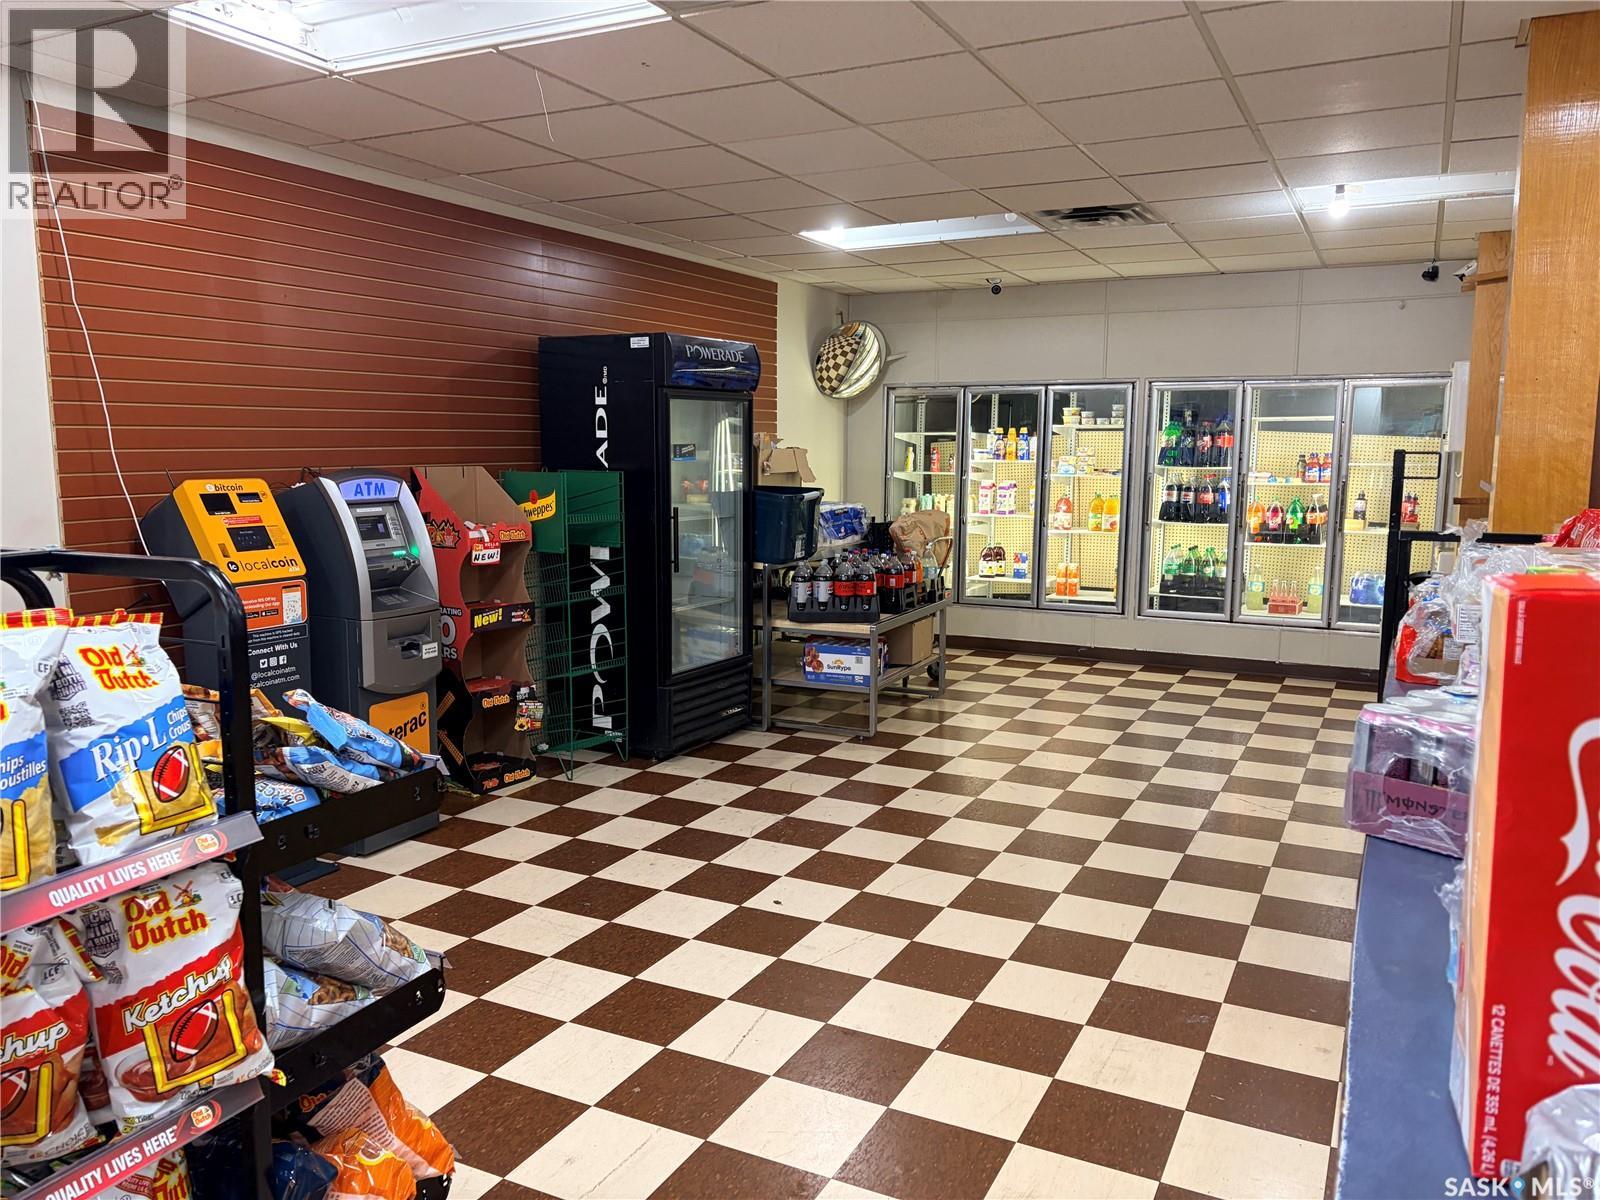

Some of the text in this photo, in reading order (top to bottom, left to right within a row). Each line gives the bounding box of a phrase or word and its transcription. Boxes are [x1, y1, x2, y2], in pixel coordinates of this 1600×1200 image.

[685, 344, 748, 363] POWERADE
[214, 483, 244, 492] bitcoin
[354, 481, 386, 497] ATM
[524, 502, 553, 518] hweppes
[240, 557, 298, 571] localcoin
[473, 550, 499, 562] NEW!
[474, 608, 503, 628] New!
[78, 646, 125, 667] Old
[248, 645, 274, 656] Connect
[274, 643, 288, 652] With
[95, 668, 159, 690] Dutch
[250, 674, 300, 689] ocalcoinatm.com
[251, 666, 296, 681] @localcoinatm
[167, 710, 188, 725] Chips
[388, 711, 427, 740] terac
[0, 760, 47, 791] oustilles
[49, 846, 182, 908] QUALITY LIVES HERE
[122, 890, 171, 923] Old
[127, 908, 209, 952] Dutch
[123, 953, 234, 1035] Ketchup
[1491, 1004, 1506, 1016] 12
[0, 1021, 70, 1064] hup
[1488, 1018, 1505, 1075] CANETTES
[1486, 1076, 1501, 1092] DE
[1484, 1093, 1500, 1114] 355
[1483, 1115, 1497, 1132] mL
[104, 1146, 143, 1179] LIVES
[142, 1127, 177, 1157] HERE
